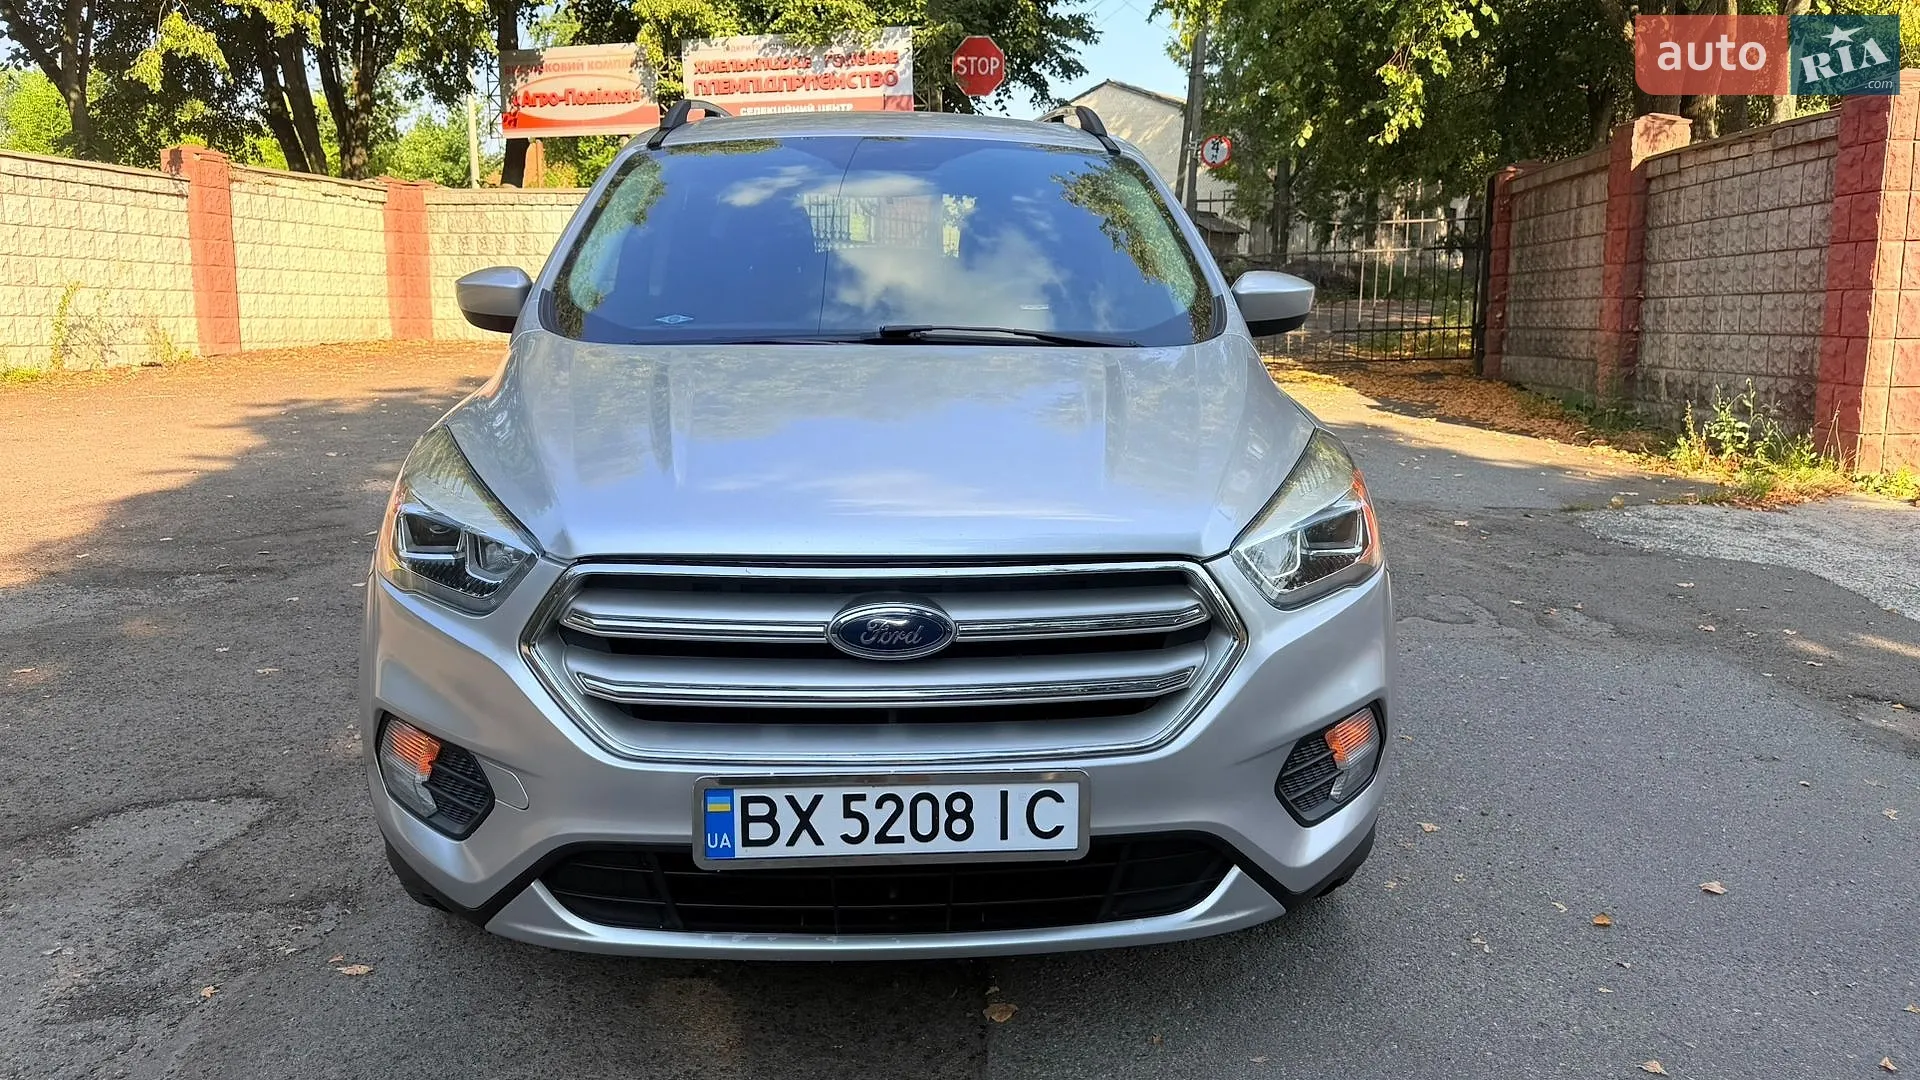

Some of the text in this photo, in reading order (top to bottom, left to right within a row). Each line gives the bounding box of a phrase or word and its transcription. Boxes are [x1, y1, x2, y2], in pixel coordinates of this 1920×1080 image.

[956, 56, 1000, 75] STOP
[694, 69, 899, 96] ПЛЕМПІДПРИЄМСТВО
[859, 618, 925, 645] Ford
[740, 789, 1065, 848] BX 5208 IC
[707, 833, 732, 849] UA
